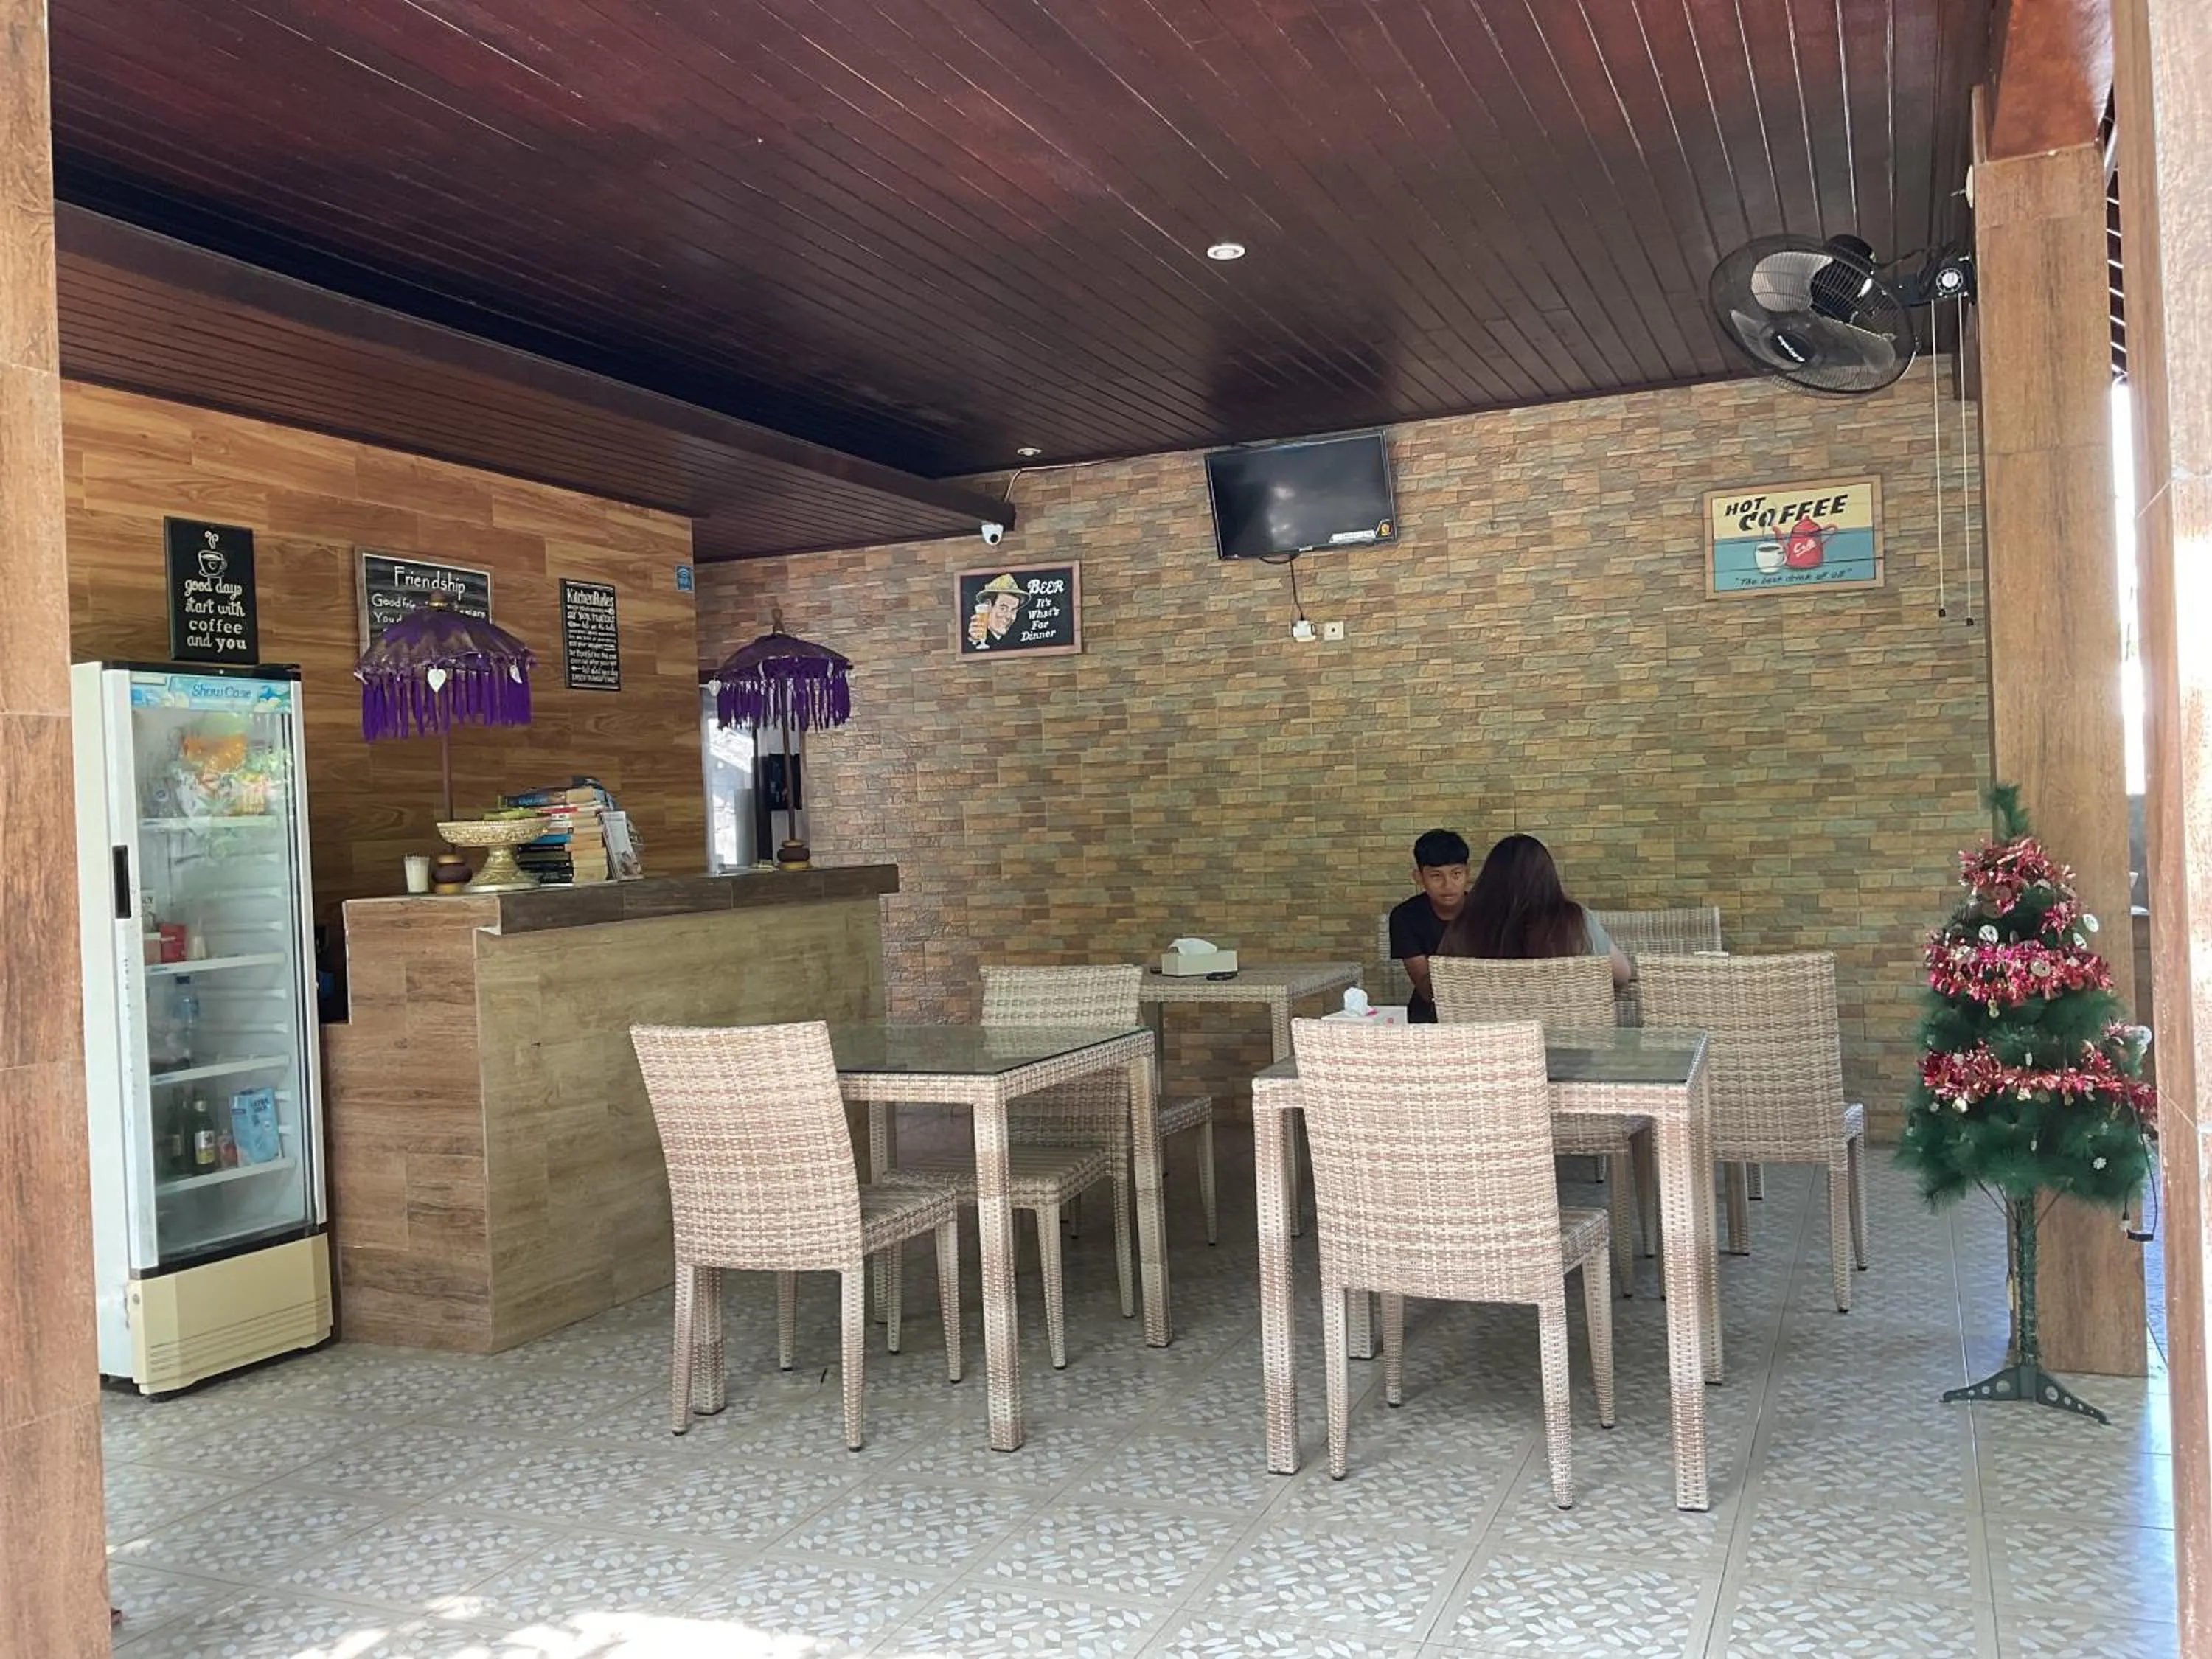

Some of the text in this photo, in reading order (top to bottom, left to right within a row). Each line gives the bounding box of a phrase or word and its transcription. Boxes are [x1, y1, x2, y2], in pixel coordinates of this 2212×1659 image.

[1725, 496, 1767, 516] HOT
[1739, 494, 1849, 532] COFFEE
[185, 579, 243, 600] good days
[394, 566, 465, 601] Friendship
[1027, 579, 1064, 594] BEER
[185, 597, 246, 616] start with
[371, 593, 401, 608] Good
[1036, 597, 1052, 608] It's
[374, 611, 394, 623] You
[1029, 607, 1060, 620] What's
[189, 619, 243, 634] coffee
[1032, 619, 1049, 630] For
[187, 633, 247, 653] and you
[1020, 630, 1057, 642] Dinner
